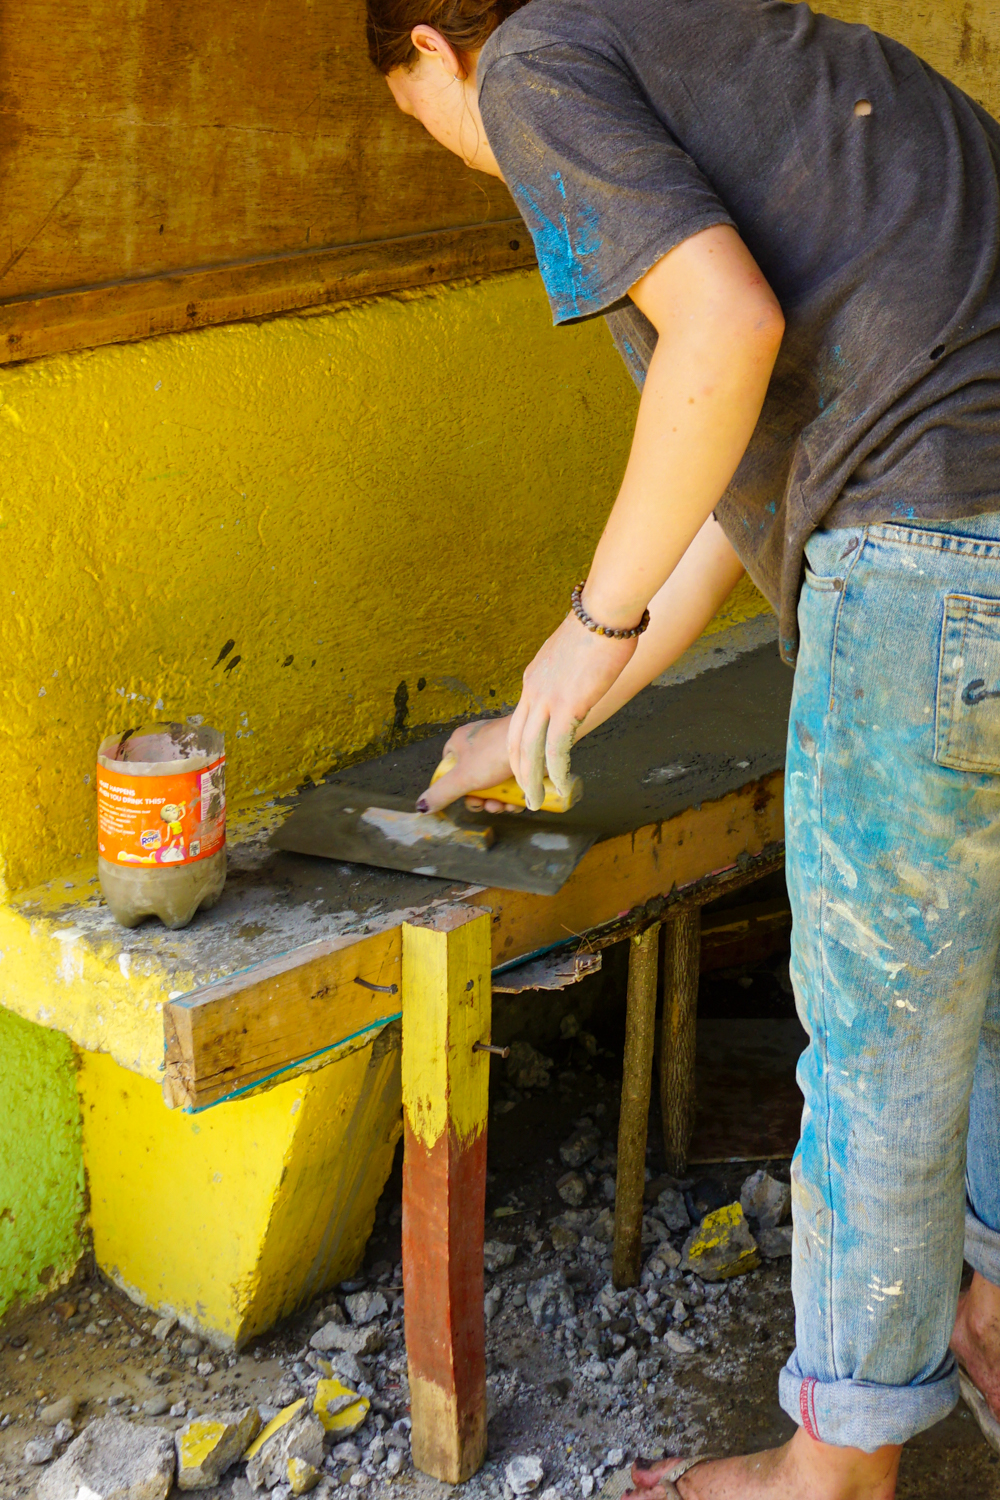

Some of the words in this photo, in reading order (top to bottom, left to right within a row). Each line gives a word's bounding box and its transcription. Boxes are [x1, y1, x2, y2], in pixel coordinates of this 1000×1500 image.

[109, 784, 136, 797] HAPPENS
[109, 793, 122, 802] YOU
[122, 796, 143, 805] DRINK
